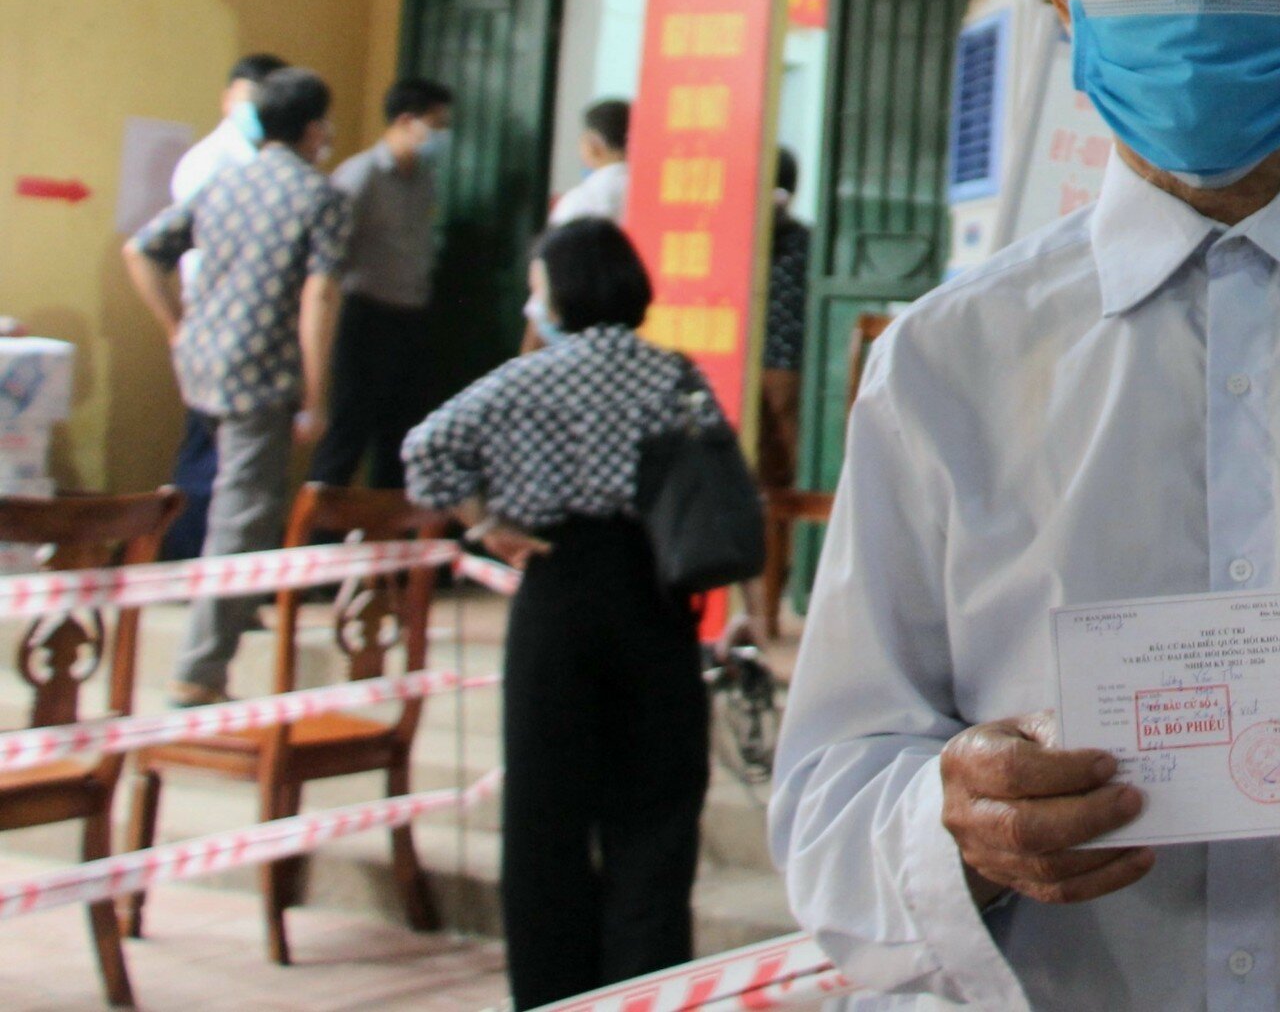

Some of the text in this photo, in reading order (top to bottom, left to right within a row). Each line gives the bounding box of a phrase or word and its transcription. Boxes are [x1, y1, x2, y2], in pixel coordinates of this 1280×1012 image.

[1163, 699, 1182, 711] BẦU
[1184, 697, 1197, 710] CỬ
[1199, 696, 1211, 709] SỐ
[1144, 721, 1161, 736] ĐÃ
[1165, 717, 1183, 735] BỎ
[1187, 713, 1225, 733] PHIẾU
